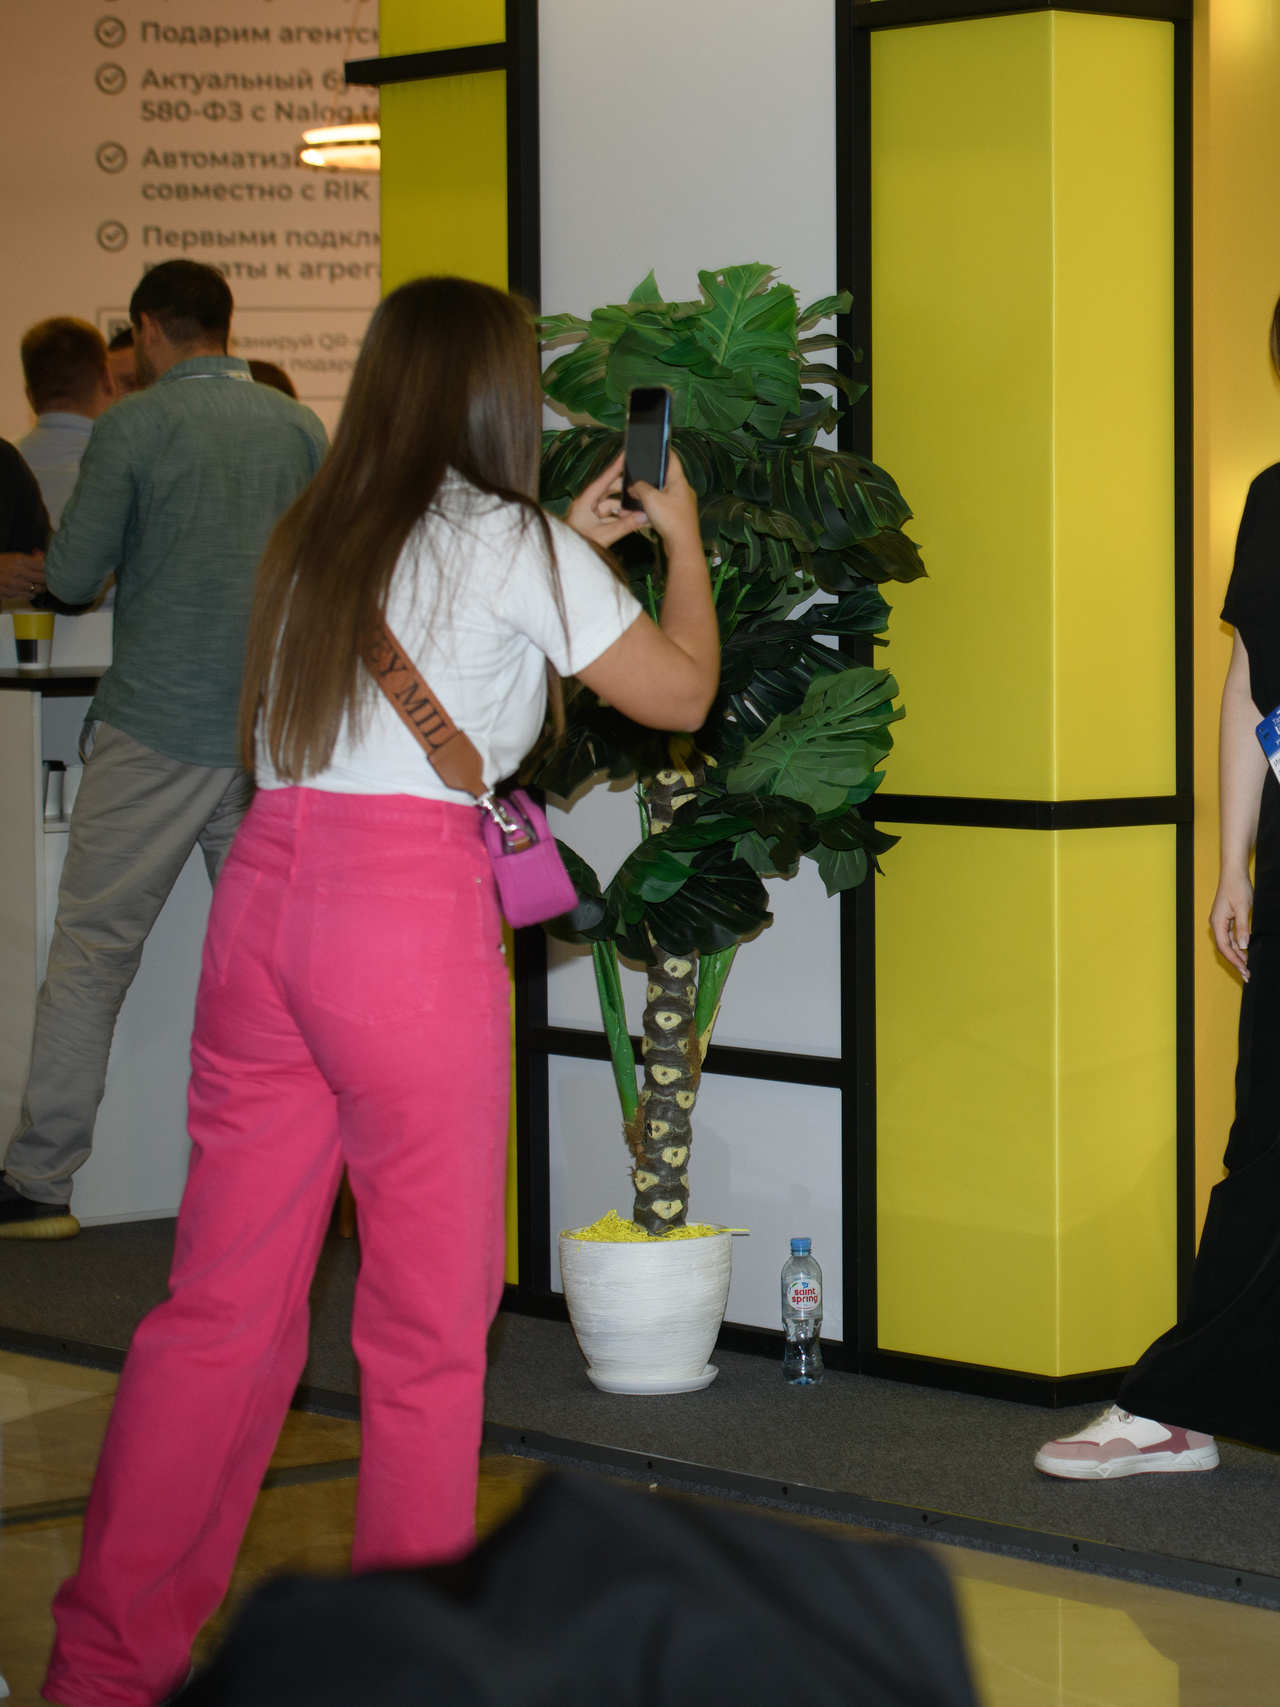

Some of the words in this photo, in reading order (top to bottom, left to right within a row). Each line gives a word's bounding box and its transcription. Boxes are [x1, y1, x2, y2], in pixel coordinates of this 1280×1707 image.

[141, 20, 270, 47] Подарим
[141, 68, 313, 95] Актуальный
[142, 183, 293, 200] совместно
[301, 183, 316, 200] с
[324, 179, 371, 200] RIK
[143, 226, 277, 250] Первыми
[792, 1295, 818, 1305] spring
[794, 1288, 815, 1296] saint
